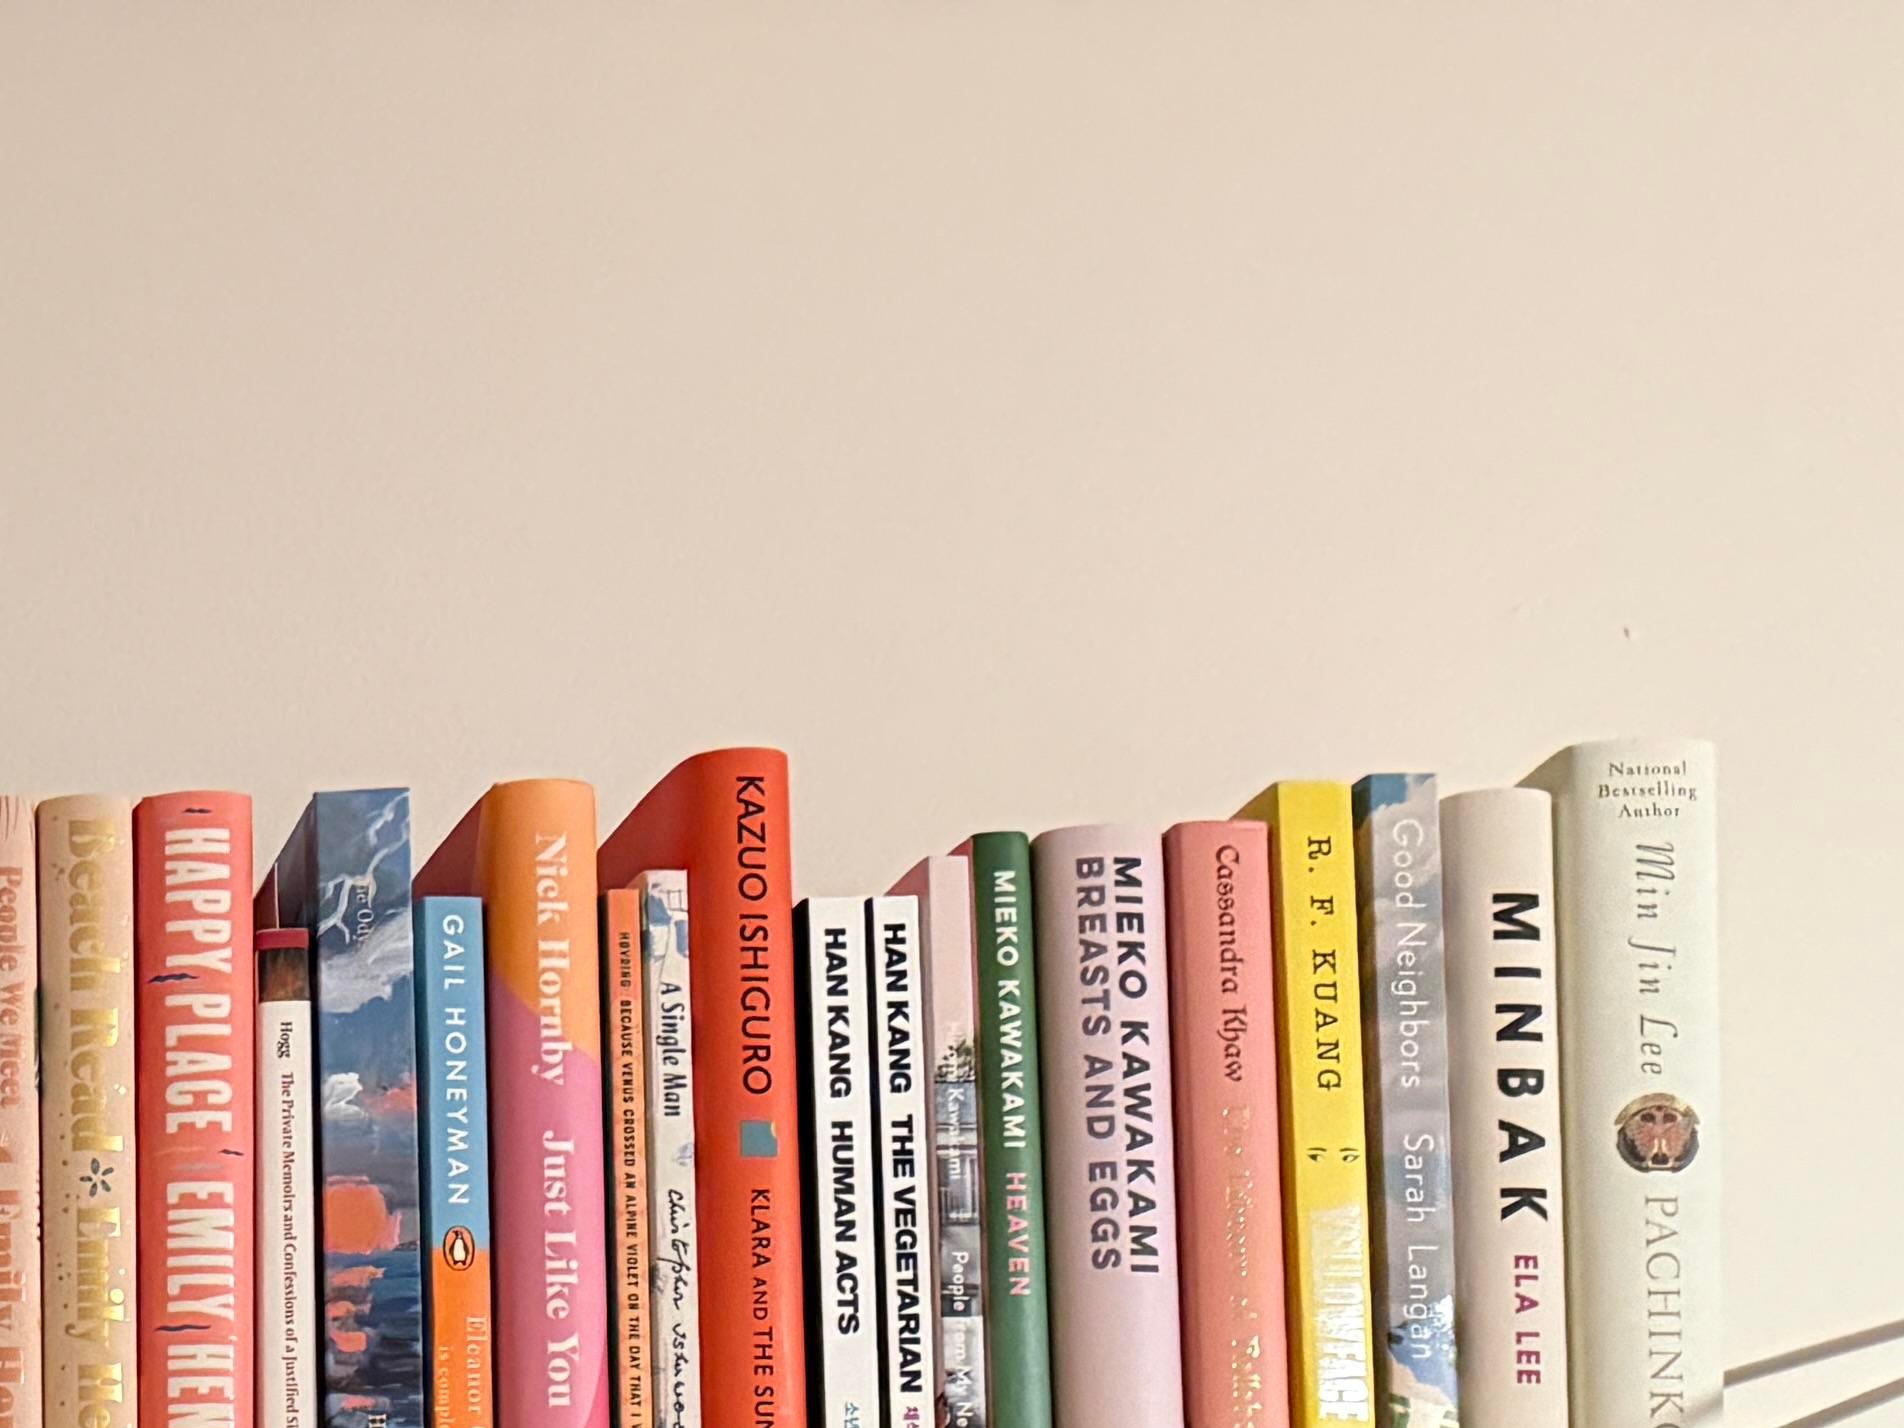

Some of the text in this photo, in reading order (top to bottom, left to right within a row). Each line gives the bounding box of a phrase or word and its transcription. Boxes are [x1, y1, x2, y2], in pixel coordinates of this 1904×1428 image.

[1596, 782, 1699, 801] Bestselling
[1607, 761, 1688, 778] National
[1617, 803, 1682, 818] Author
[162, 828, 233, 1135] HAPPY PLACE
[734, 775, 775, 1097] KAZUO ISHIGURO
[823, 927, 852, 1100] HAN KANG
[1489, 891, 1552, 1223] MINBAK
[831, 1119, 862, 1337] HUMAN ACTS
